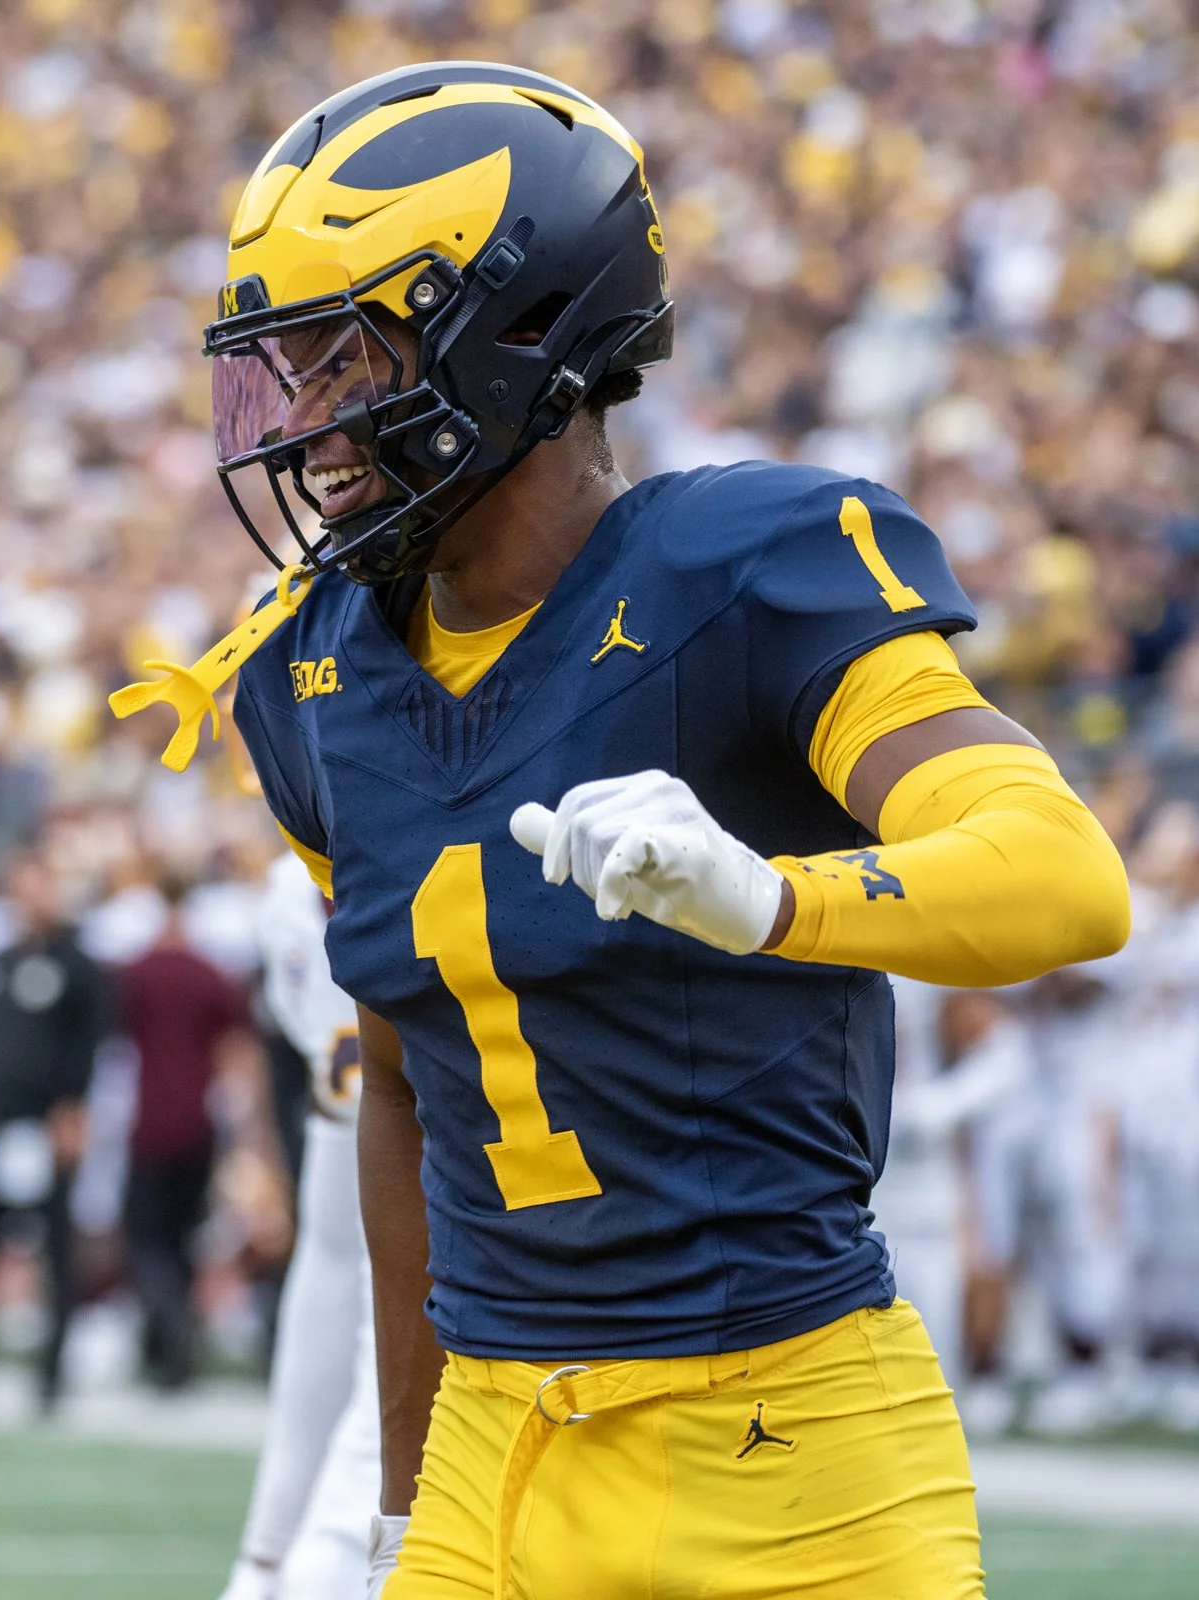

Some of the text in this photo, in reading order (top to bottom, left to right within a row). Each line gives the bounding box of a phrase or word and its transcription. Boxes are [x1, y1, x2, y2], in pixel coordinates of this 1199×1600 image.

[223, 285, 239, 318] M
[838, 495, 928, 614] 1
[830, 850, 906, 901] M
[410, 842, 603, 1212] 1
